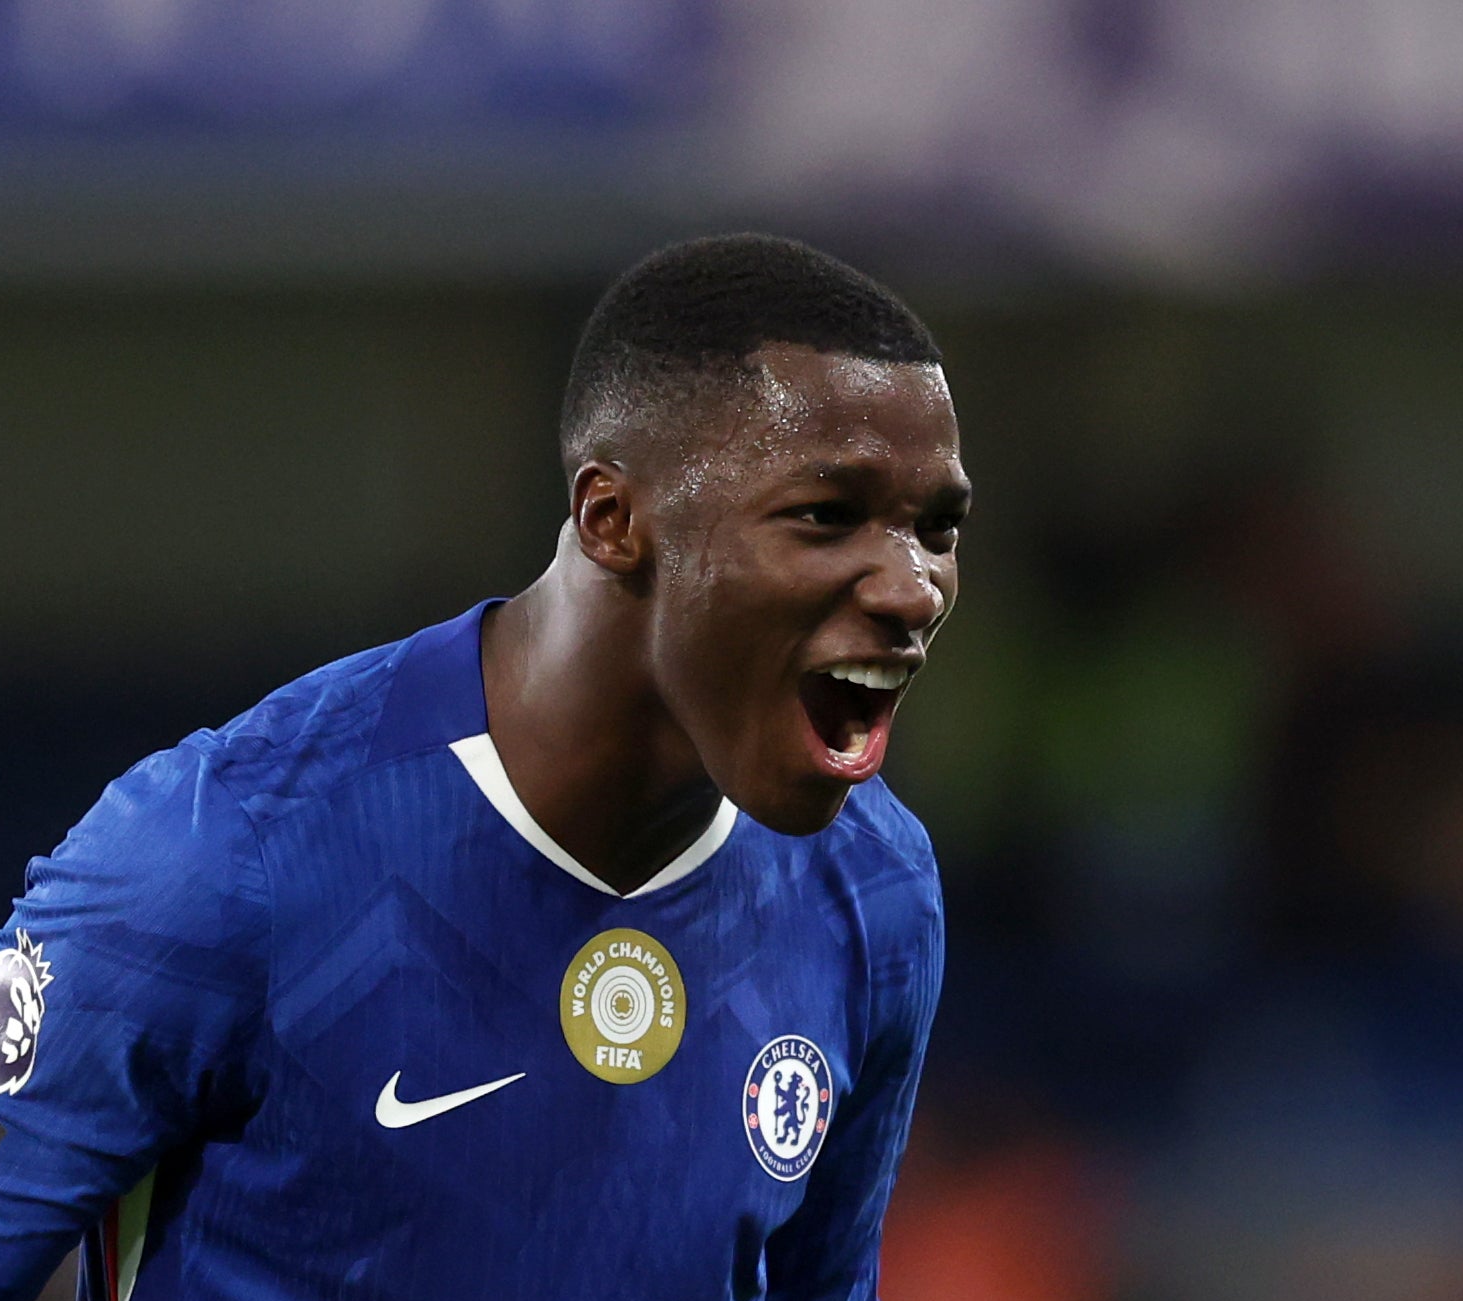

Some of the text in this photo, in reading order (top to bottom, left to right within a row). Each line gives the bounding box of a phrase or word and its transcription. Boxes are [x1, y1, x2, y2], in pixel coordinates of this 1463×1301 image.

[572, 942, 676, 1028] WORLD CHAMPIONS
[596, 1045, 642, 1070] FIFA
[761, 1041, 822, 1074] CHELSEA
